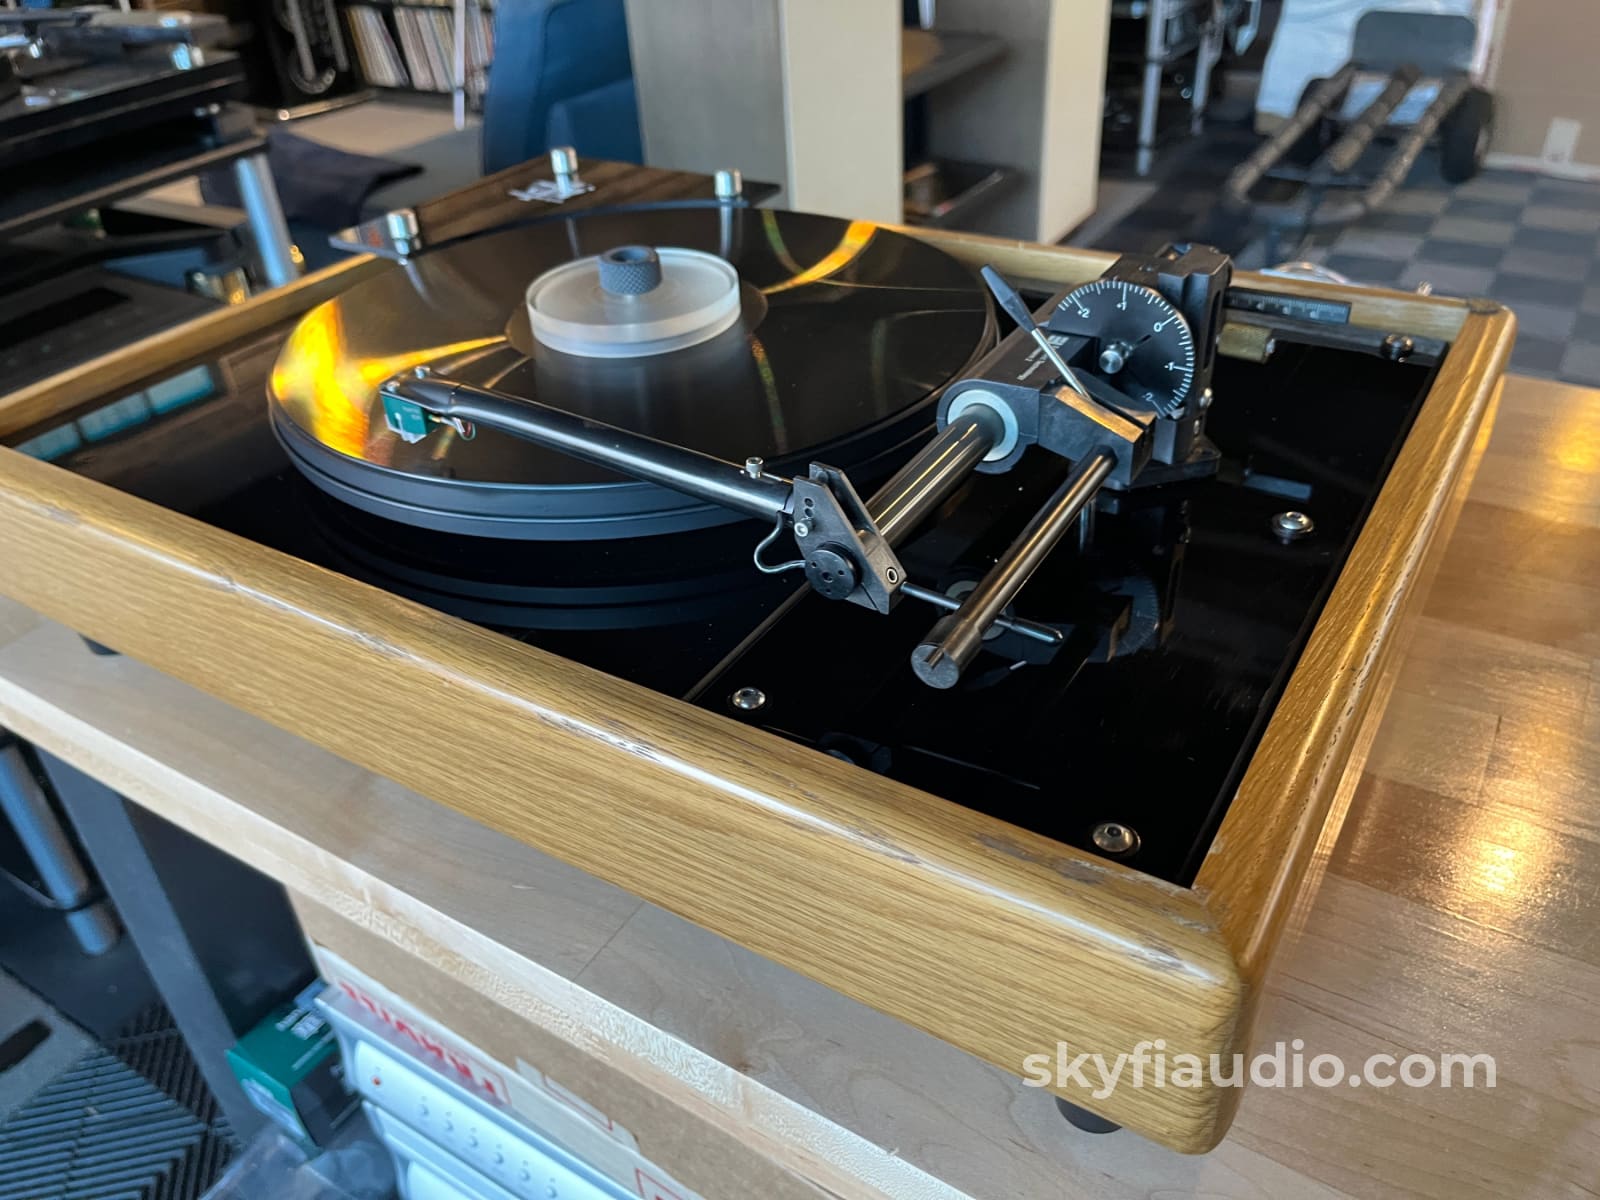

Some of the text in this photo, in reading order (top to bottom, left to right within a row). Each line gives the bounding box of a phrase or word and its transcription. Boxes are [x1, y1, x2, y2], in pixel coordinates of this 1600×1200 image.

[1153, 321, 1163, 332] 0
[1164, 361, 1175, 371] -1
[1142, 392, 1153, 401] -2
